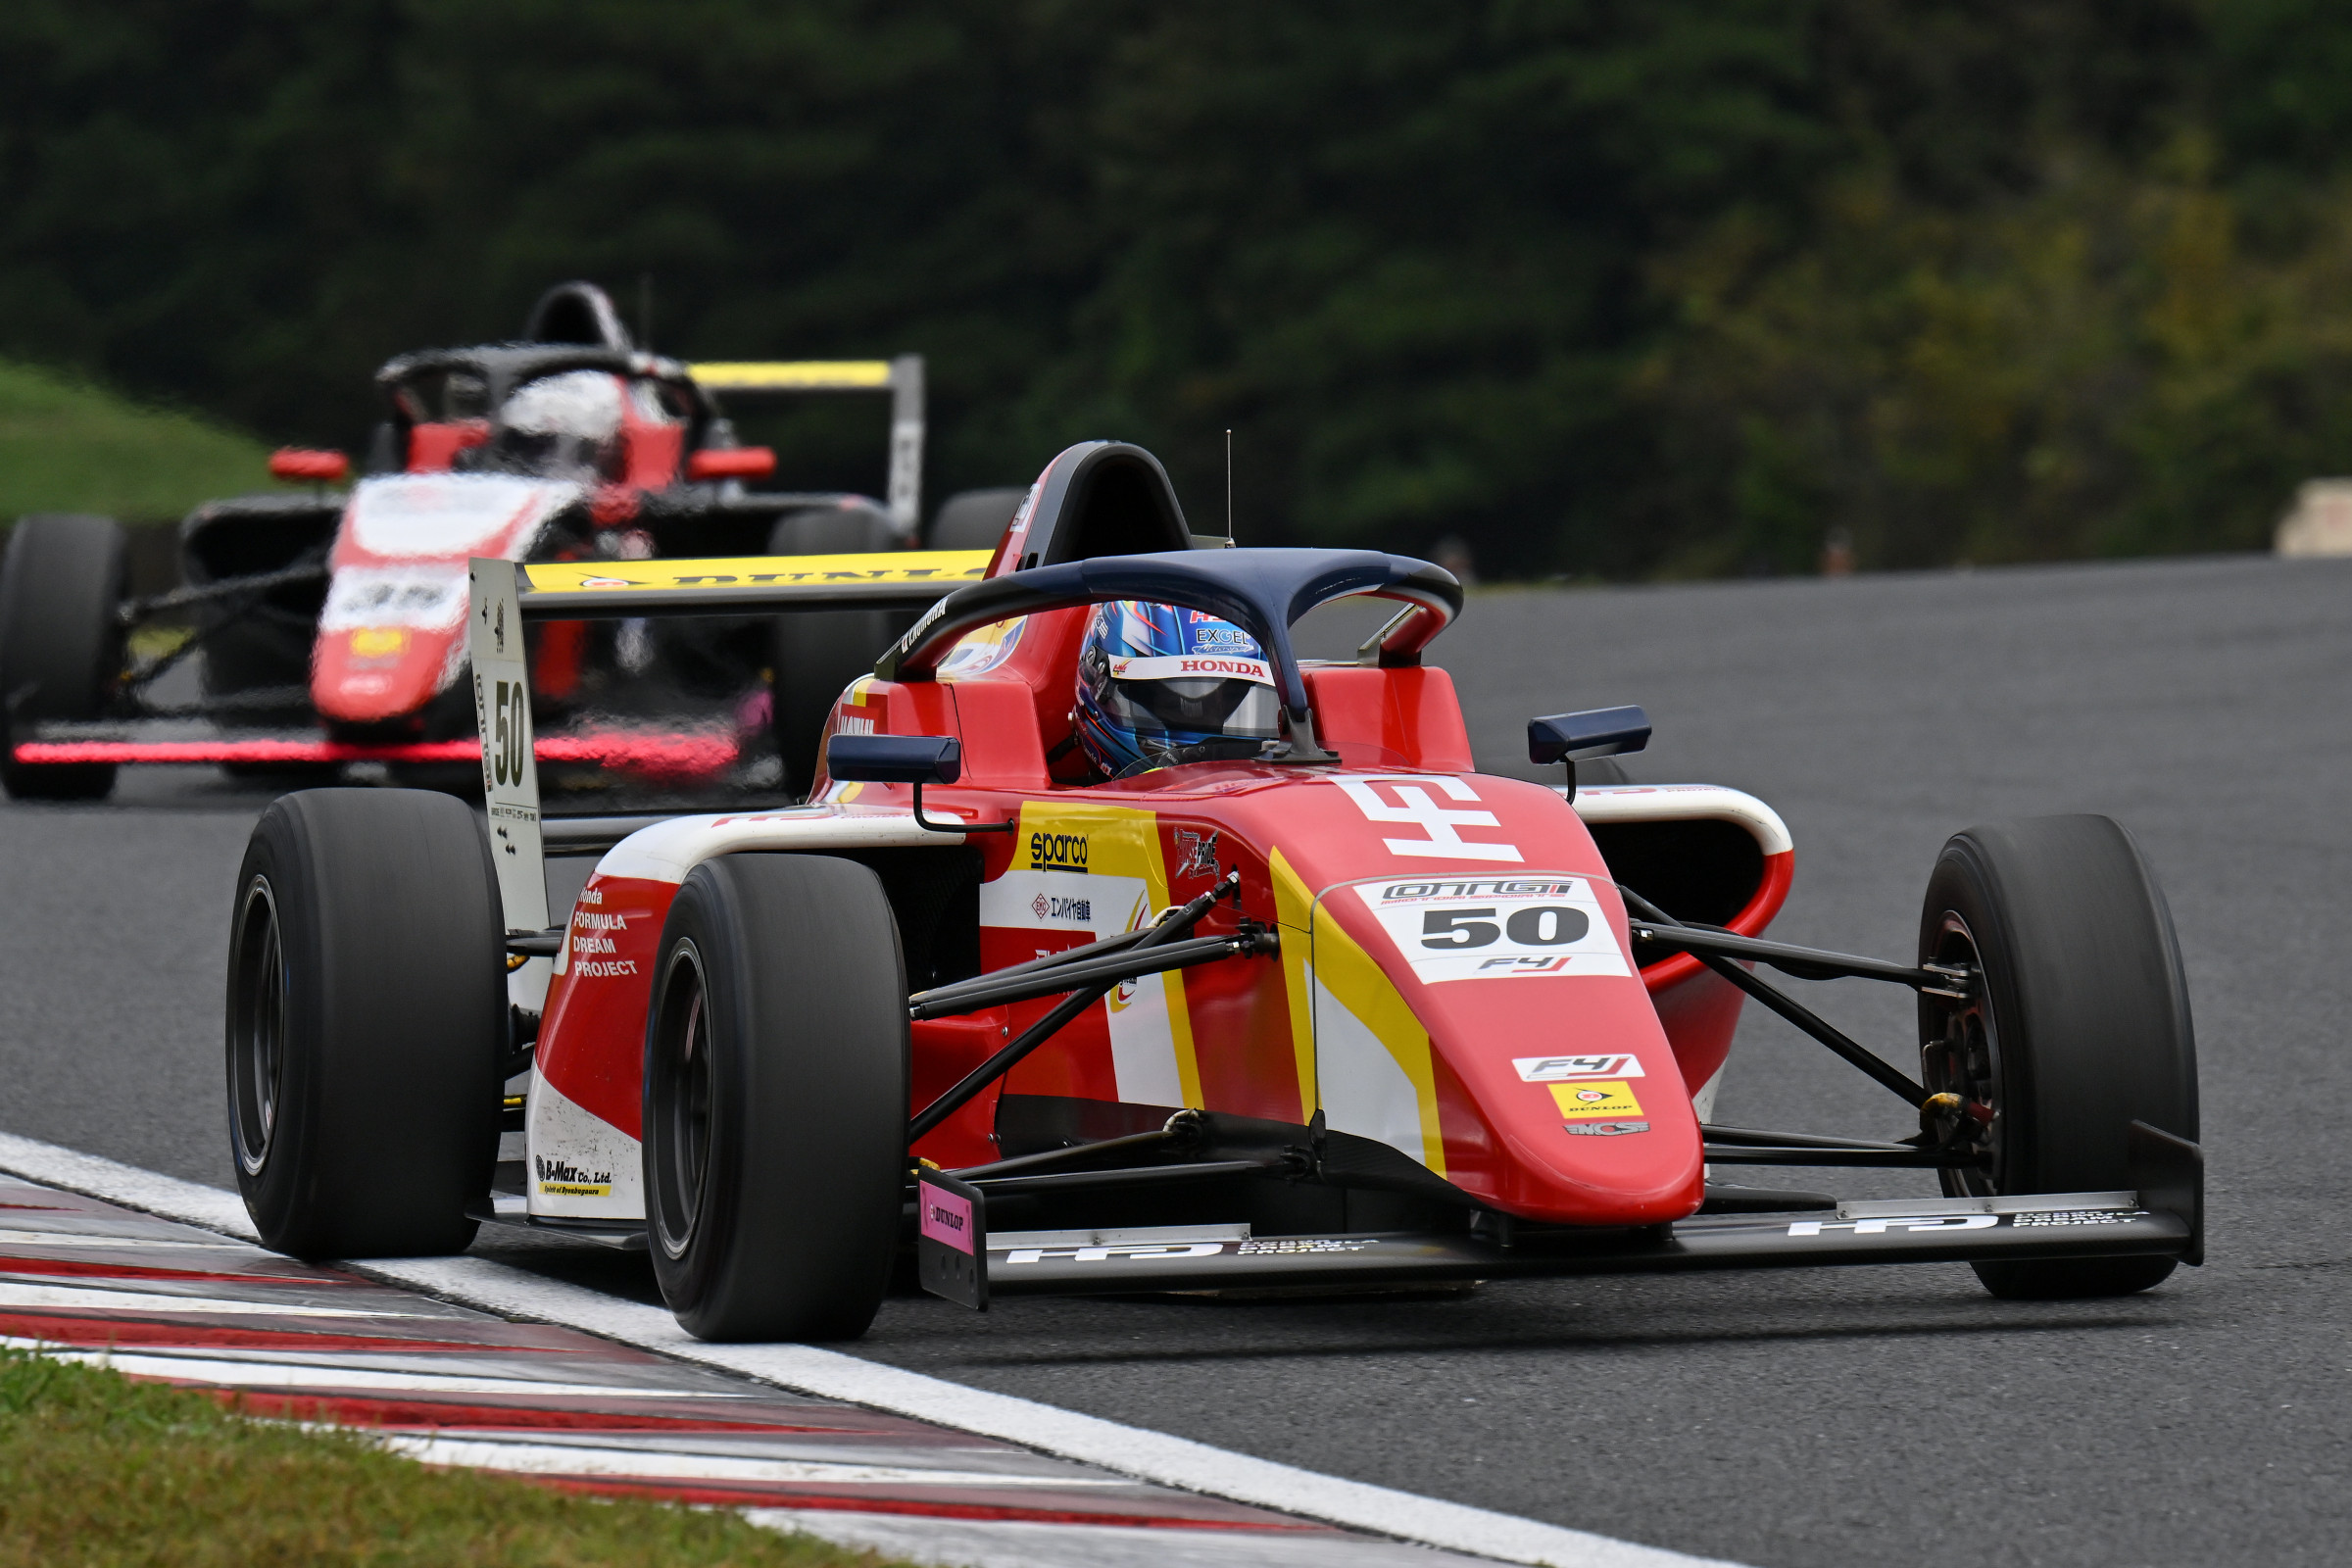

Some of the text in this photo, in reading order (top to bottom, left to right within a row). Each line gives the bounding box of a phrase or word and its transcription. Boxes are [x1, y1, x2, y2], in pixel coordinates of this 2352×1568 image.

[1197, 628, 1250, 646] EXGEL
[1180, 660, 1265, 678] HONDA
[495, 680, 524, 788] 50
[1031, 832, 1088, 871] sparco
[579, 887, 603, 905] Honda
[1051, 897, 1091, 922] エンパイヤ自動車
[574, 910, 627, 930] FORMULA
[1421, 906, 1590, 950] 50
[573, 935, 616, 954] DREAM
[574, 960, 638, 977] PROJECT
[1567, 1104, 1634, 1113] DUNLOP
[546, 1159, 578, 1182] B-Max
[593, 1172, 612, 1184] Ltd.
[936, 1206, 964, 1232] DUNLOP
[2012, 1218, 2137, 1227] PROJECT
[1238, 1246, 1365, 1255] PROJECT
